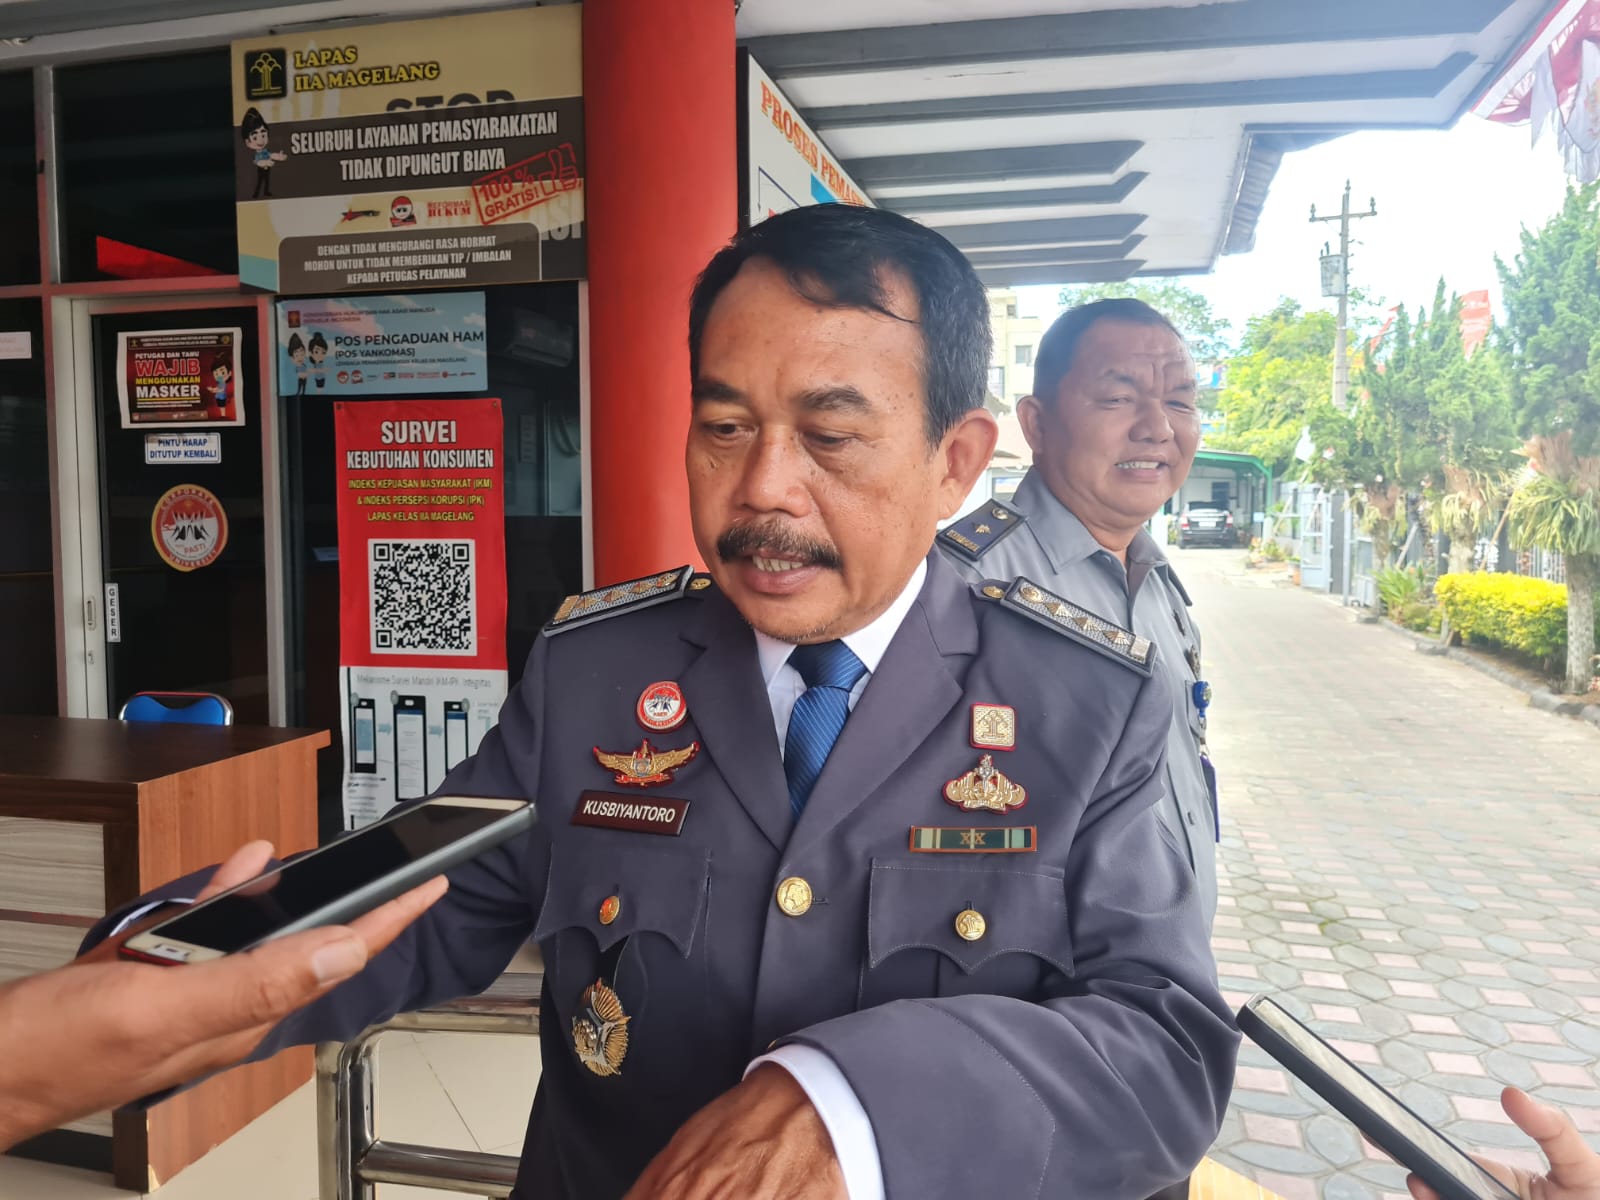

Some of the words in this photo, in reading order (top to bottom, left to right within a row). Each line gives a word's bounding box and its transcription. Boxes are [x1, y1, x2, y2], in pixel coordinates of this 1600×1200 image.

[294, 46, 358, 69] LAPAS
[294, 73, 325, 92] IIA
[328, 61, 440, 90] MAGELANG
[291, 128, 353, 154] SELURUH
[357, 123, 418, 150] LAYANAN
[422, 111, 558, 144] PEMASYARAKATAN
[760, 80, 818, 172] PROSES
[340, 157, 383, 181] TIDAK
[386, 151, 460, 178] DIPUNGUT
[463, 148, 506, 172] BIAYA
[479, 175, 513, 202] 100
[484, 186, 539, 218] GRATIS!
[317, 244, 351, 256] DENGAN
[352, 242, 377, 254] TIDAK
[378, 239, 434, 253] MENGURANGI
[435, 237, 459, 249] RASA
[460, 235, 496, 248] HORMAT
[304, 260, 335, 272] MOHON
[336, 258, 365, 270] UNTUK
[365, 256, 391, 268] TIDAK
[392, 253, 449, 267] MEMBERIKAN
[450, 252, 464, 264] TIP
[472, 250, 511, 263] IMBALAN
[347, 272, 379, 284] KEPADA
[380, 270, 418, 283] PETUGAS
[419, 267, 467, 280] PELAYANAN
[335, 335, 361, 346] POS
[365, 332, 449, 345] PENGADUAN
[453, 331, 484, 342] HAM
[135, 359, 200, 377] WAJIB
[135, 376, 201, 385] MENGGUNAKAN
[136, 385, 200, 398] MASKER
[158, 439, 180, 447] PINTU
[182, 438, 208, 447] HARAP
[381, 420, 457, 444] SURVEI
[150, 450, 182, 459] DITUTUP
[184, 449, 216, 458] KEMBALI
[347, 450, 419, 469] KEBUTUHAN
[423, 449, 494, 468] KONSUMEN
[349, 479, 375, 488] INDEKS
[378, 479, 418, 488] KEPUASAN
[421, 478, 471, 488] MASYARAKAT
[364, 495, 391, 505] INDEKS
[393, 495, 429, 505] PERSEPSI
[431, 495, 465, 505] KORUPSI
[368, 511, 391, 521] LAPAS
[393, 511, 418, 521] KELAS
[431, 511, 474, 521] MAGELANG
[109, 587, 117, 637] GESER
[583, 800, 676, 823] KUSBIYANTORO
